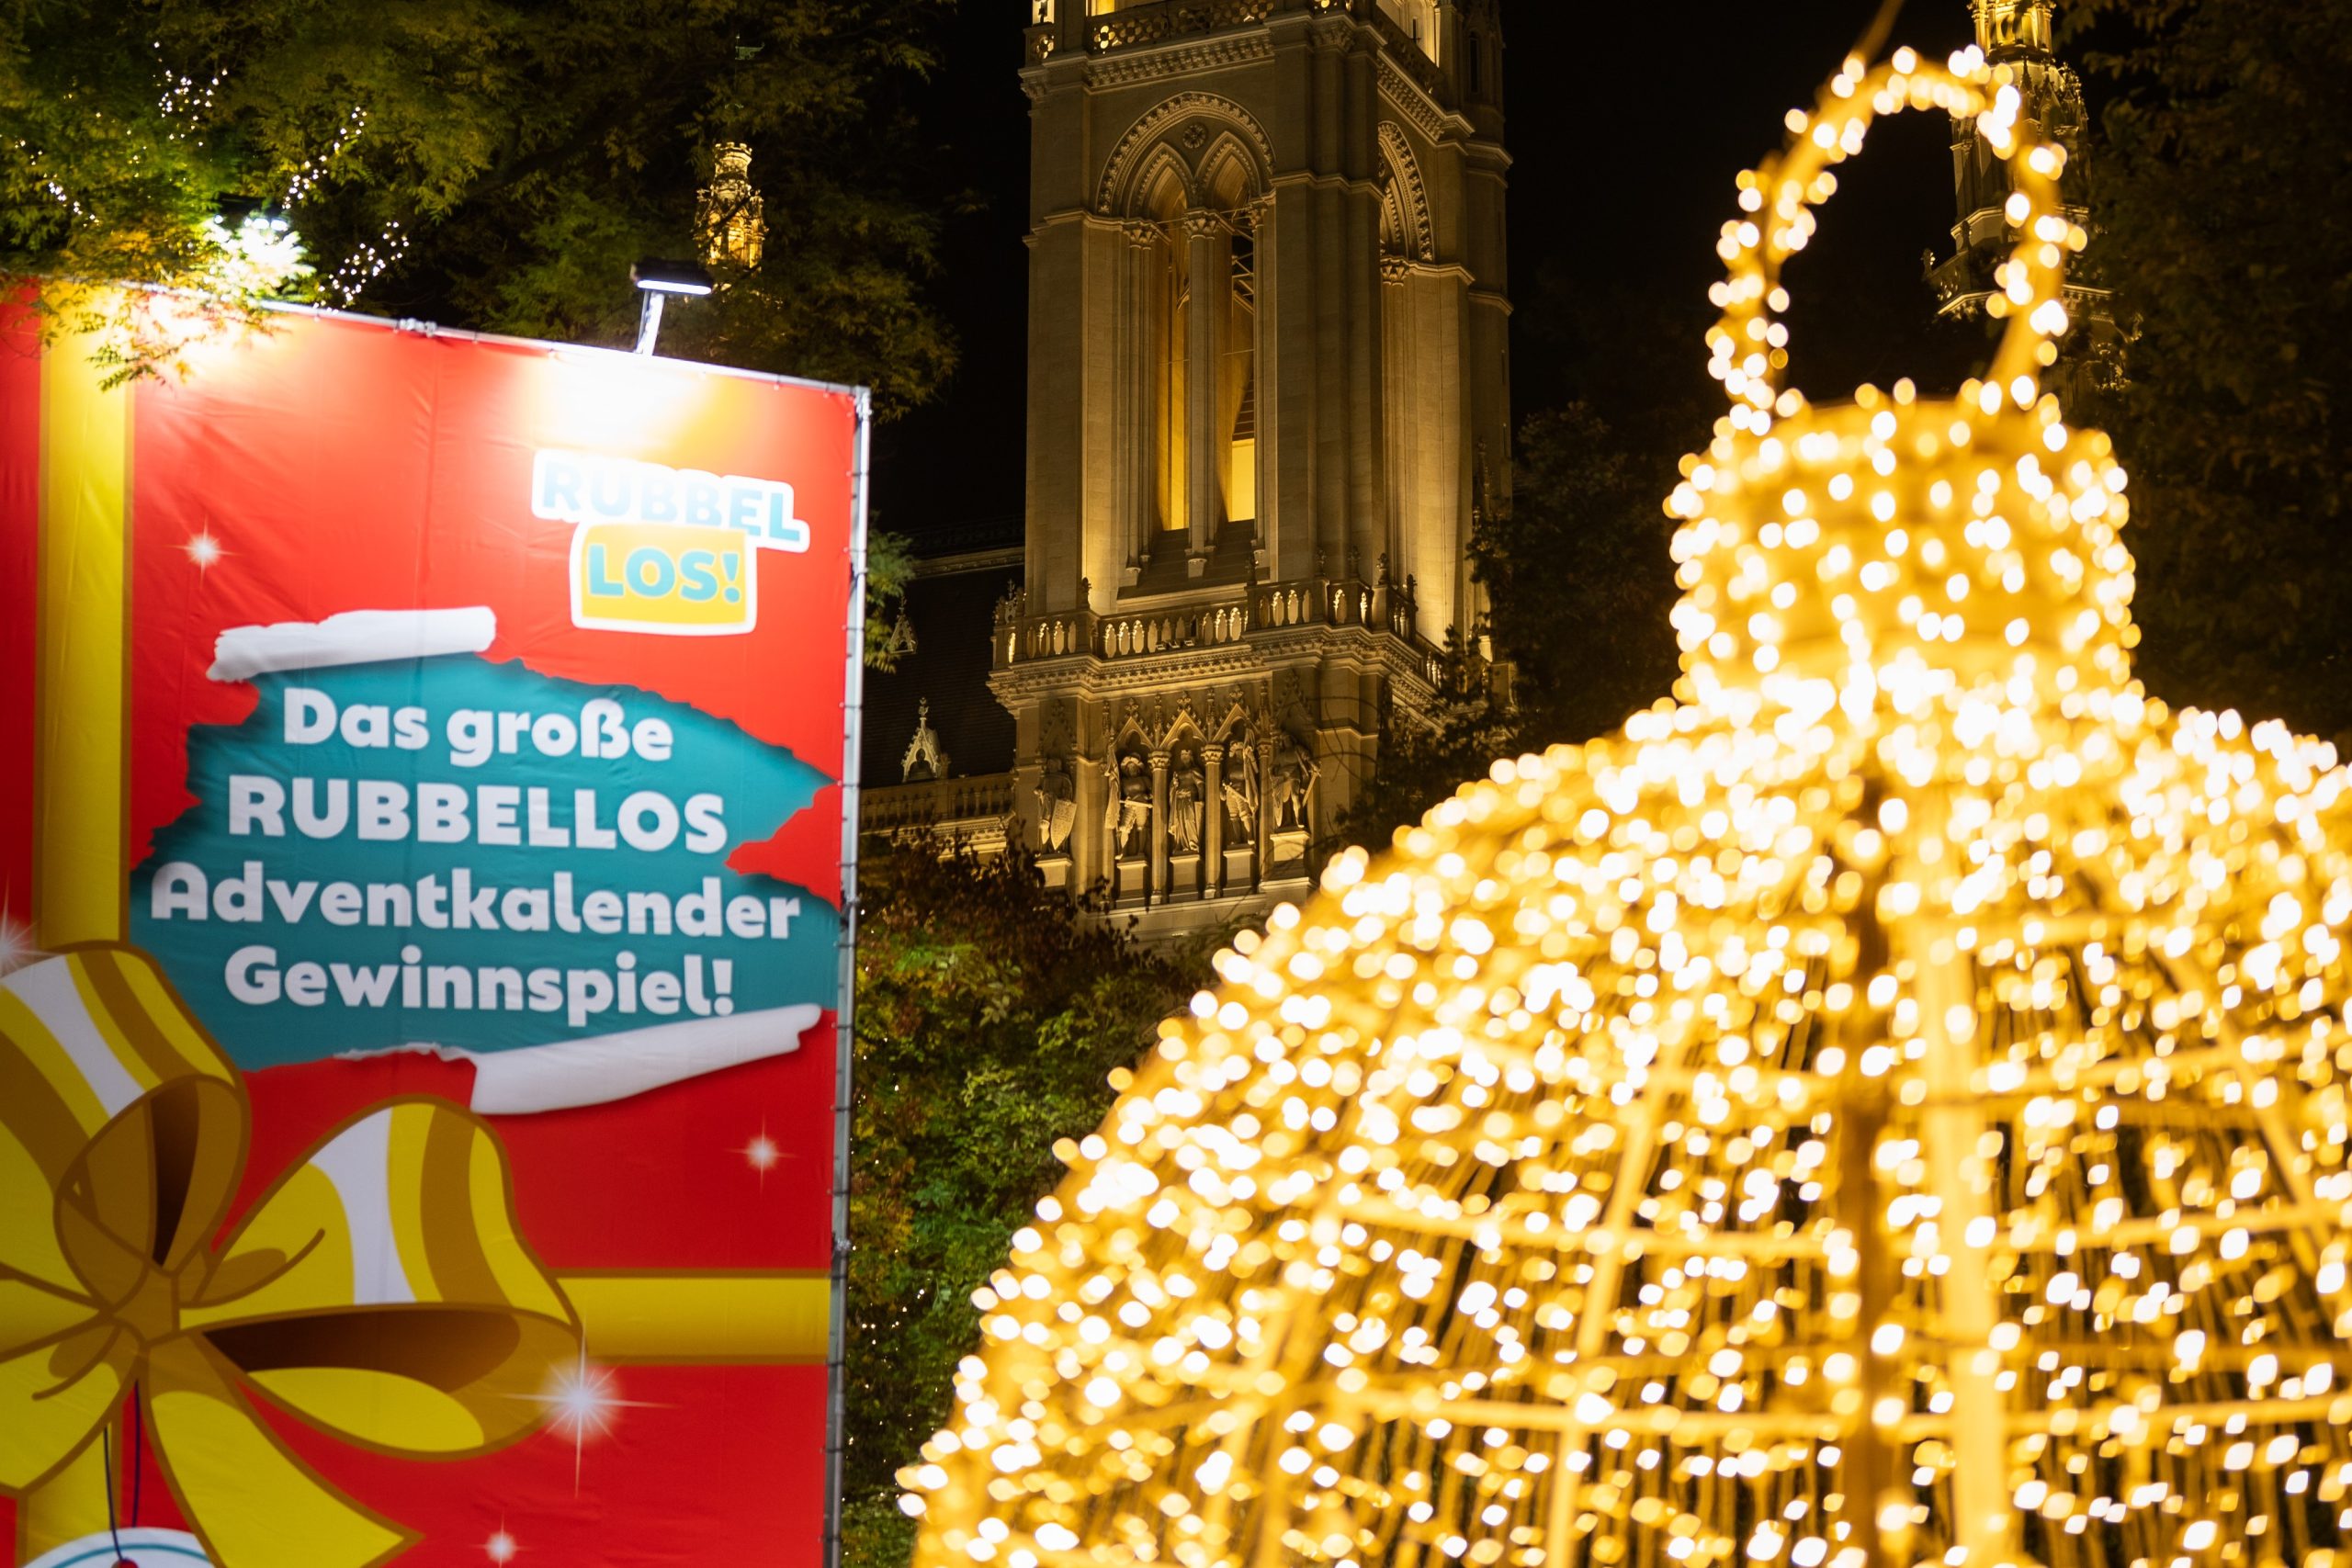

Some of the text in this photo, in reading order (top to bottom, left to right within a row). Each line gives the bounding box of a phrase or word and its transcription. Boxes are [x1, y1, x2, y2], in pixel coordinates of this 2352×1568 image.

[543, 461, 800, 543] RUBBEL
[588, 544, 741, 604] LOS!
[283, 687, 673, 767] Das große
[228, 775, 728, 854] RUBBELLOS
[151, 861, 800, 940] Adventkalender
[224, 945, 734, 1027] Gewinnspiel!
